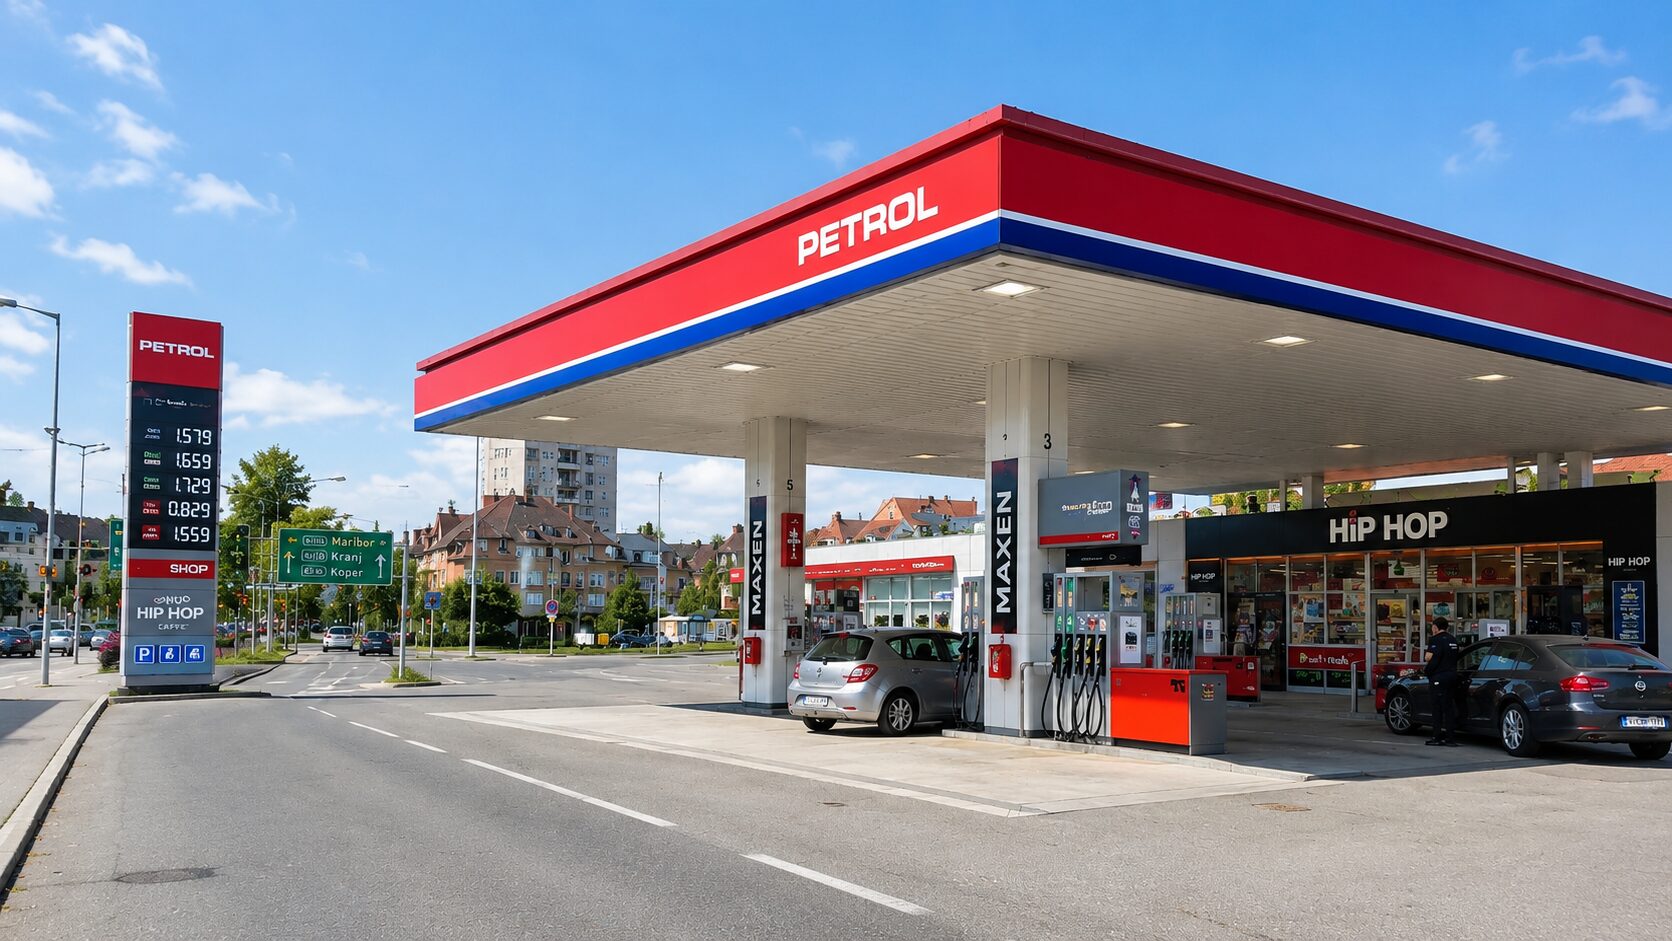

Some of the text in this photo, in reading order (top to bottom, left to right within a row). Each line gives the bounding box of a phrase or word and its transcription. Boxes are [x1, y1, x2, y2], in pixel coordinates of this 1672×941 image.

[798, 186, 939, 266] PETROL
[139, 339, 215, 359] PETROL
[1043, 433, 1052, 450] 3
[786, 479, 794, 491] 5
[168, 500, 211, 518] 0.829
[1383, 511, 1448, 540] HOP
[331, 536, 375, 547] Maribor
[331, 552, 362, 565] Kranj
[996, 490, 1012, 614] MAXEN
[752, 520, 763, 616] MAXEN
[1608, 556, 1651, 567] HIP HOP
[170, 564, 209, 574] SHOP
[330, 567, 363, 579] Koper
[136, 606, 204, 620] HIP HOP
[139, 647, 150, 661] P
